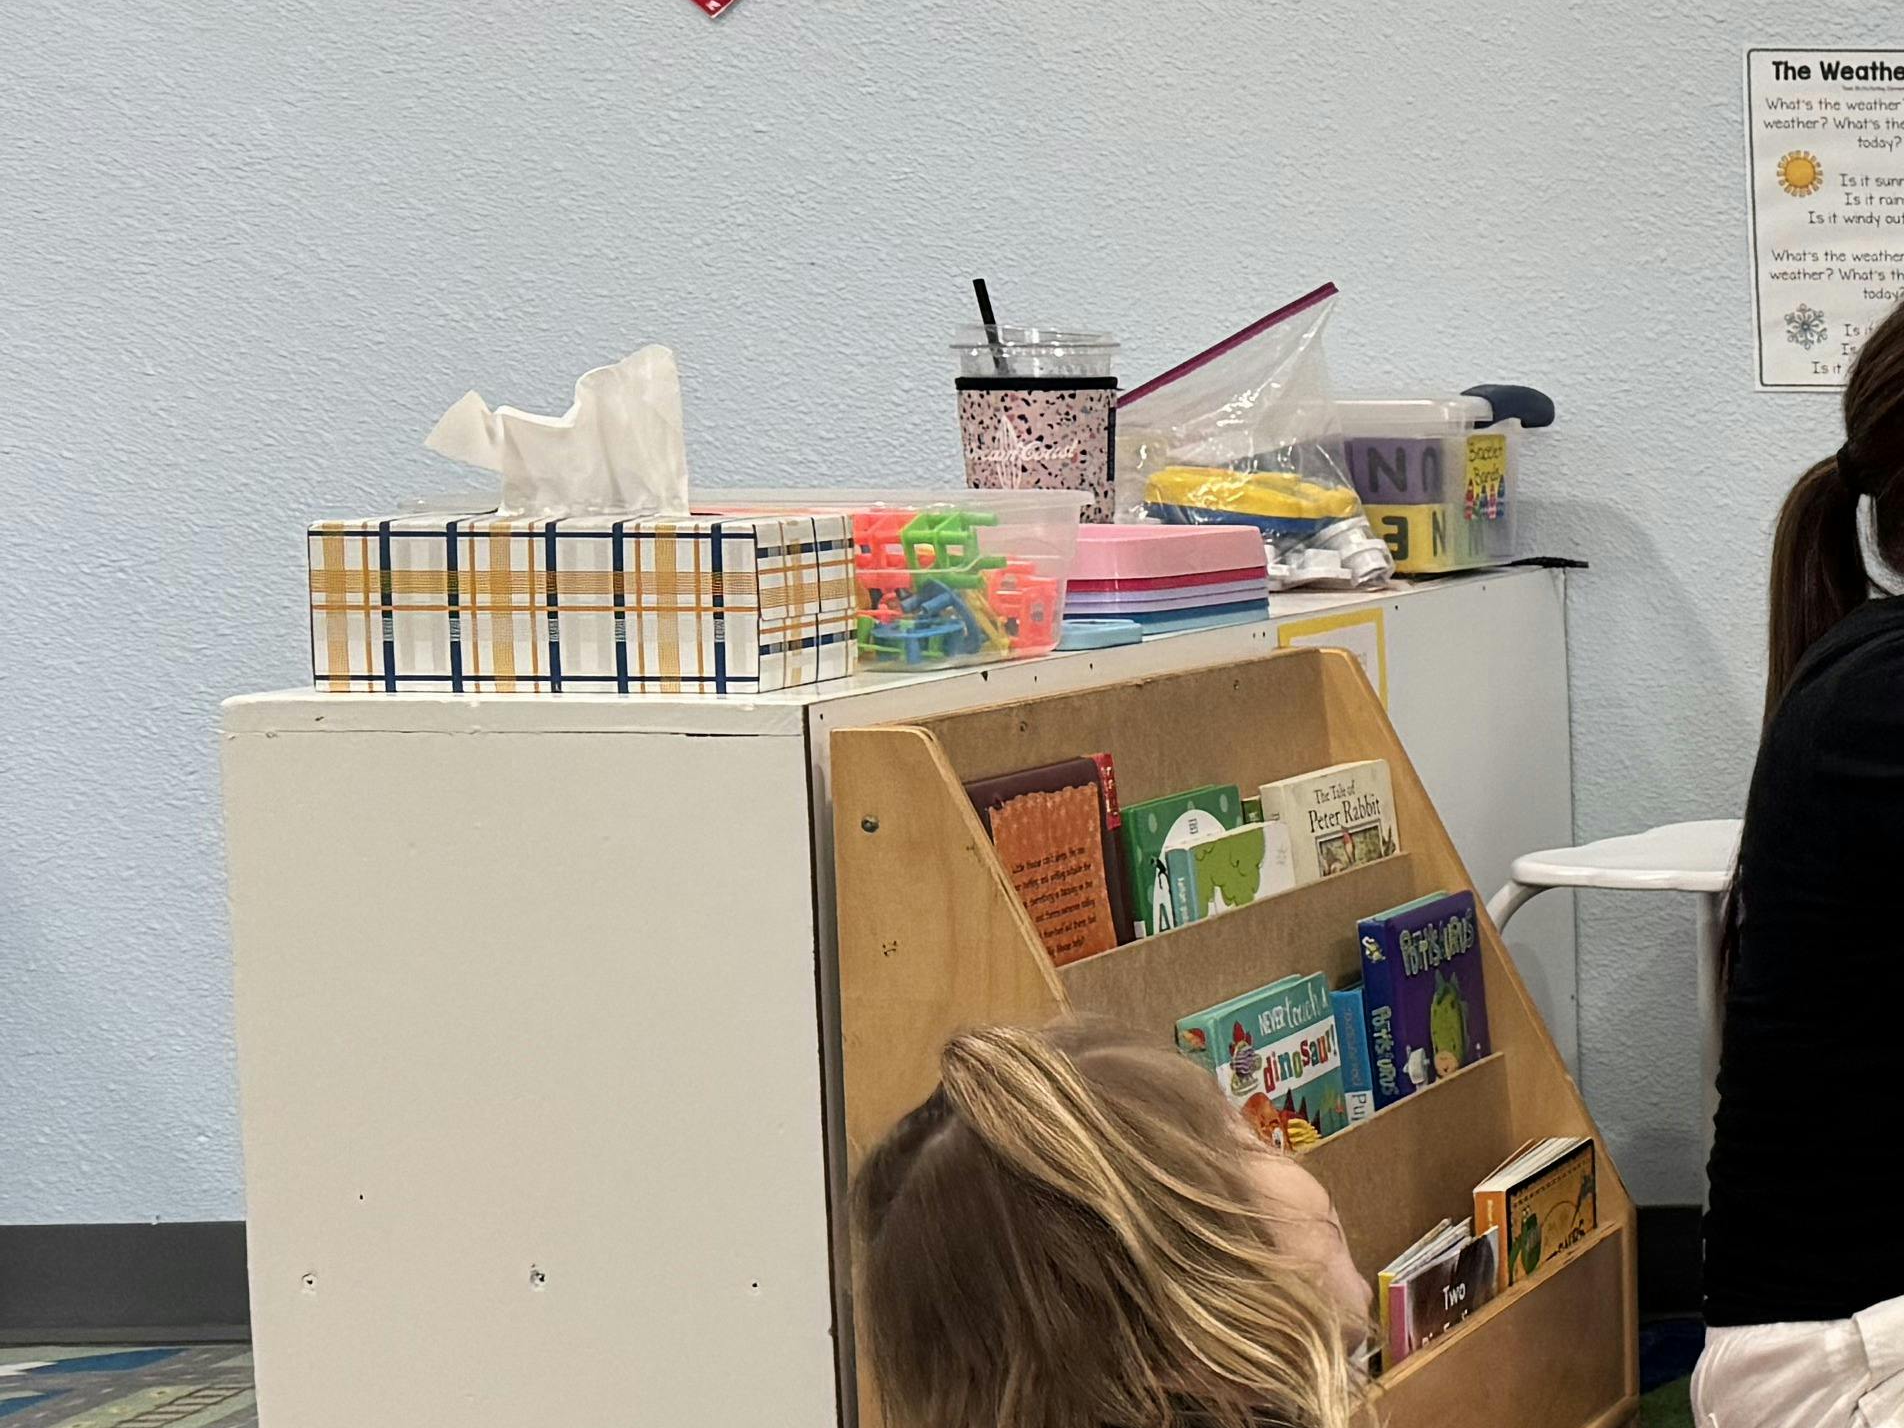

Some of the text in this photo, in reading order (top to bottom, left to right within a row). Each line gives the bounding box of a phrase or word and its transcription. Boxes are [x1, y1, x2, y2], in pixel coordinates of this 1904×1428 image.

[1772, 61, 1811, 80] The
[1766, 98, 1813, 110] What's
[1819, 98, 1840, 110] the
[1764, 117, 1828, 130] weather?
[1834, 117, 1880, 130] What's
[1858, 136, 1902, 151] today?
[1840, 174, 1858, 186] Is
[1861, 174, 1870, 187] it
[1845, 193, 1860, 205] Is
[1865, 193, 1873, 205] it
[1808, 211, 1824, 224] Is
[1829, 211, 1837, 224] it
[1843, 211, 1880, 227] windy
[1885, 212, 1904, 224] out
[1314, 788, 1330, 804] The
[1330, 783, 1346, 799] Tale
[1308, 793, 1382, 834] Peter Rabbit
[1263, 1024, 1338, 1093] dinosaur!
[1443, 1282, 1466, 1310] Two
